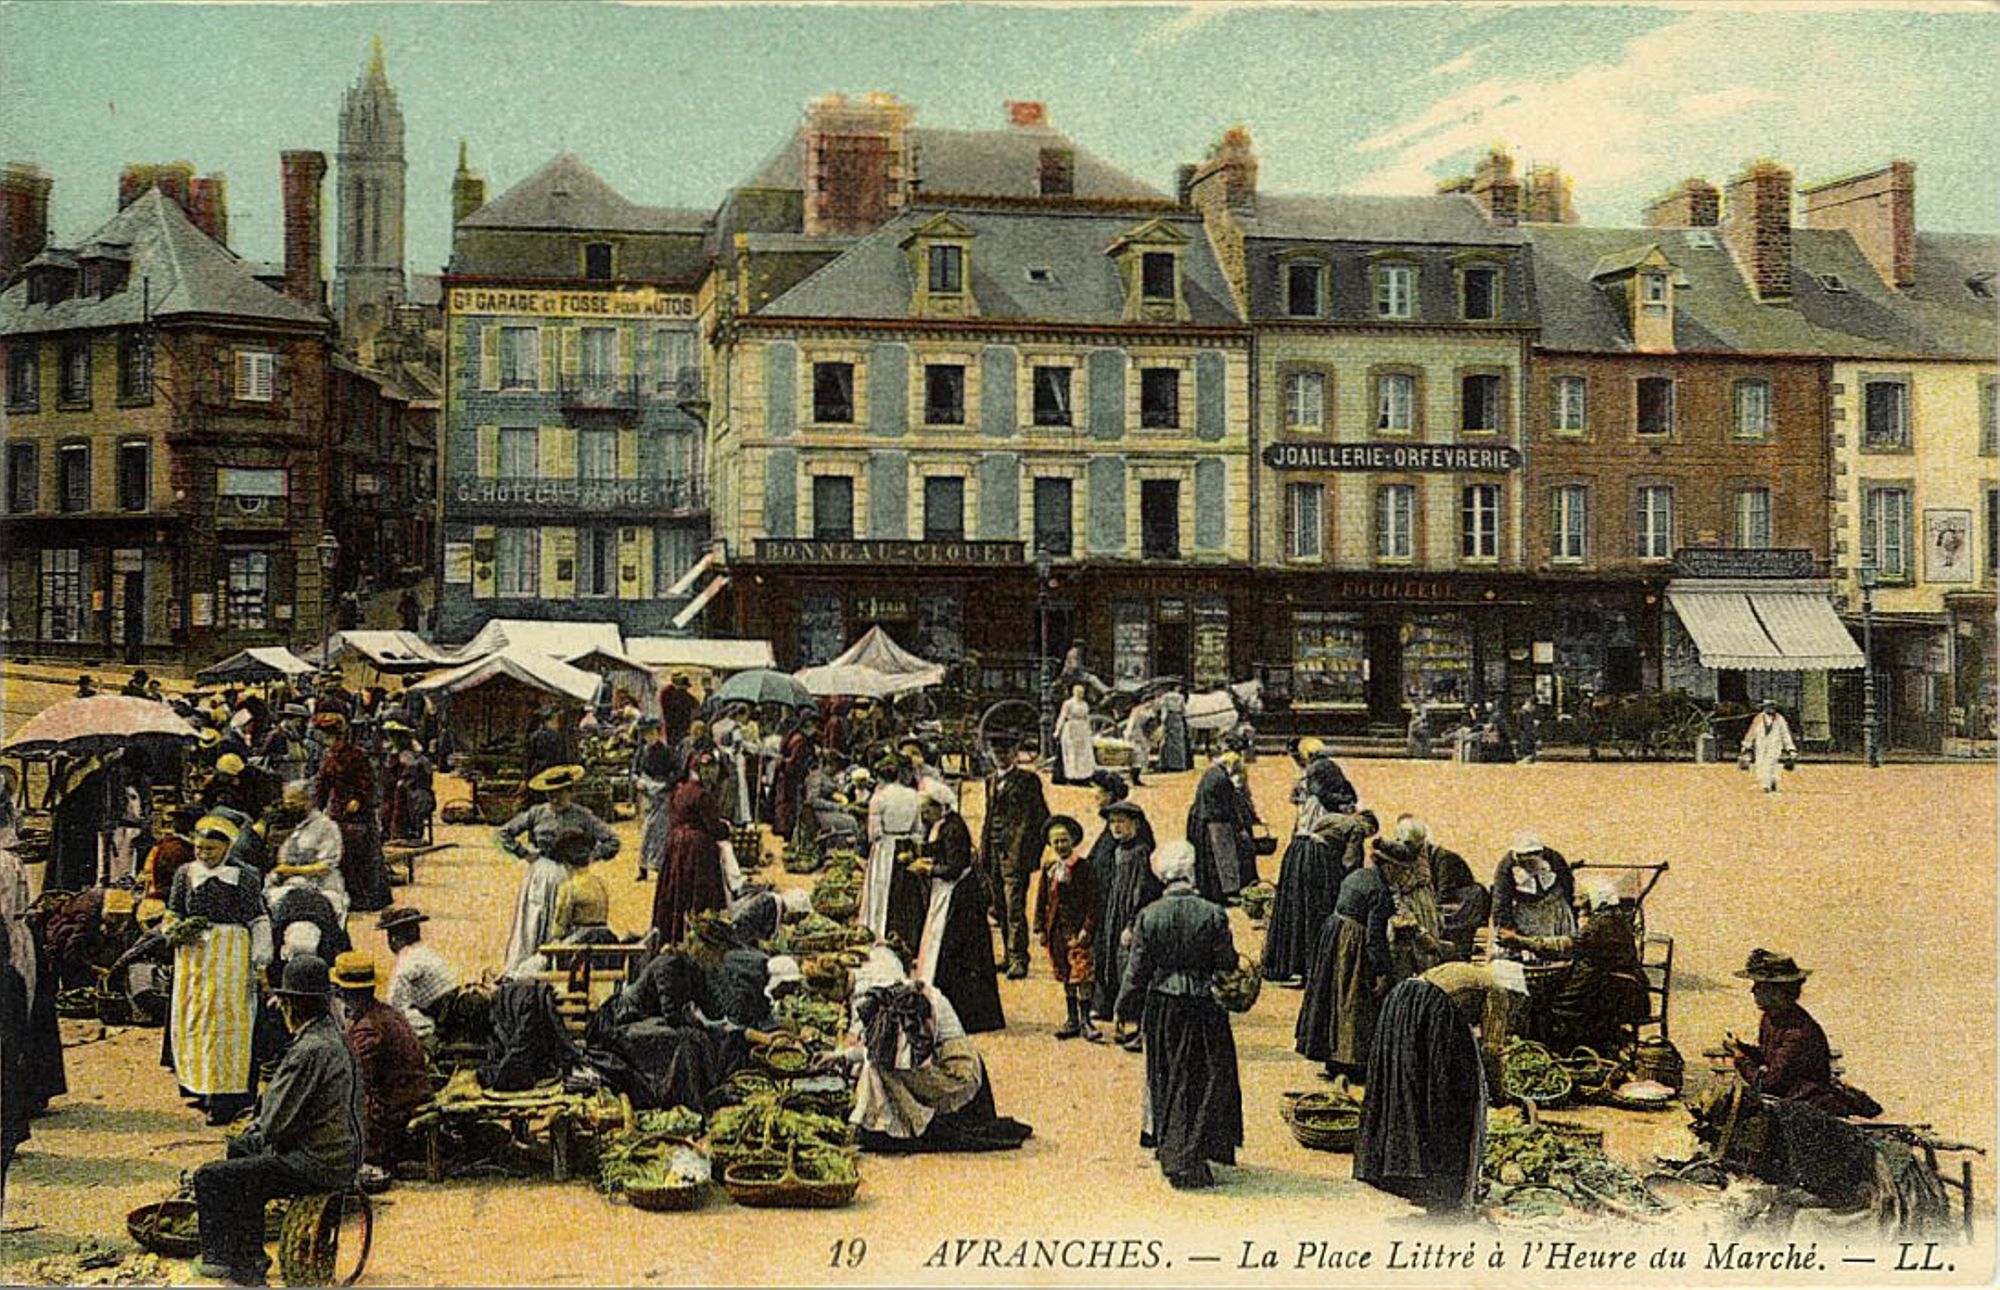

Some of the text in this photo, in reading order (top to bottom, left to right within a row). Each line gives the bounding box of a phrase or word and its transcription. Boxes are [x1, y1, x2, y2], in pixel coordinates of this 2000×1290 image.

[476, 293, 539, 312] GARAGE
[560, 295, 609, 313] FOSSE
[645, 297, 693, 316] AUTOS
[764, 541, 1012, 562] BONNEAU-CLOUET
